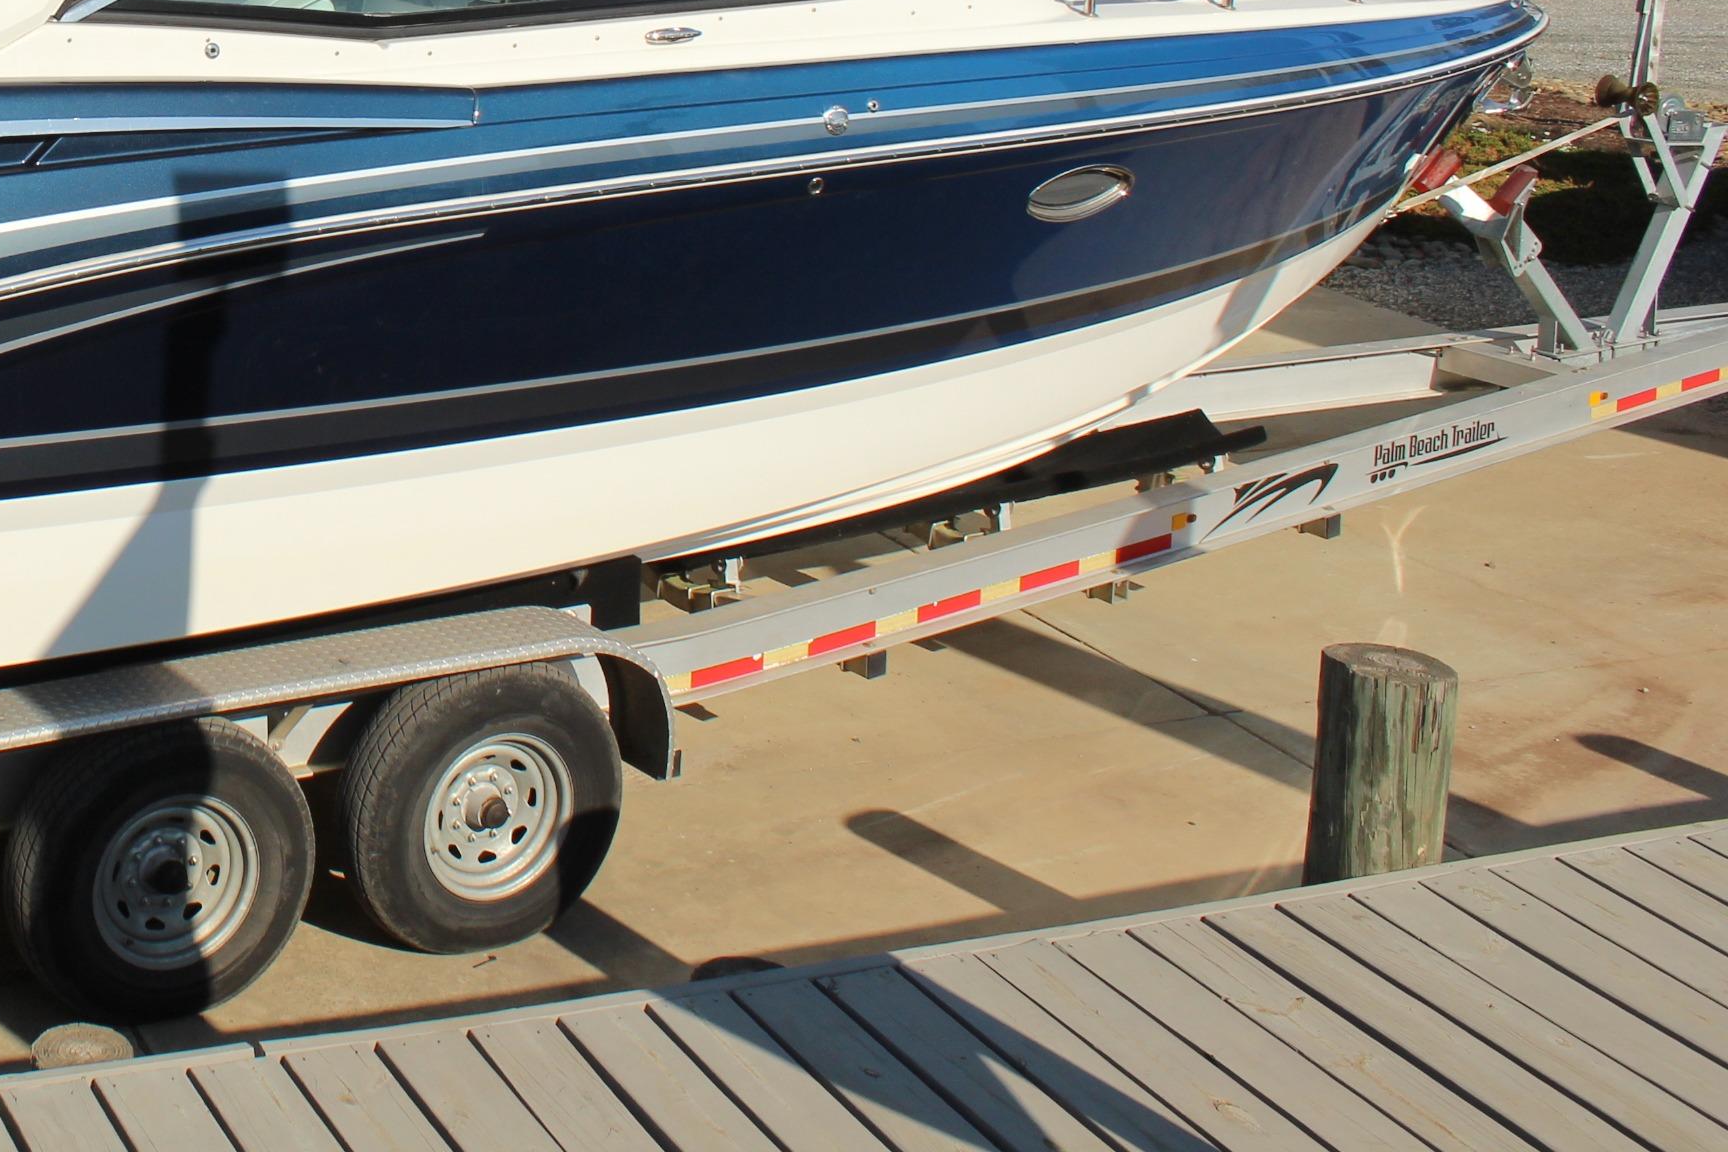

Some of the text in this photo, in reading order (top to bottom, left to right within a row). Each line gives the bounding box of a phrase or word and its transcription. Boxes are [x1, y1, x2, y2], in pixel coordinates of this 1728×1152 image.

[1374, 421, 1495, 467] Palm Beach Trailer
